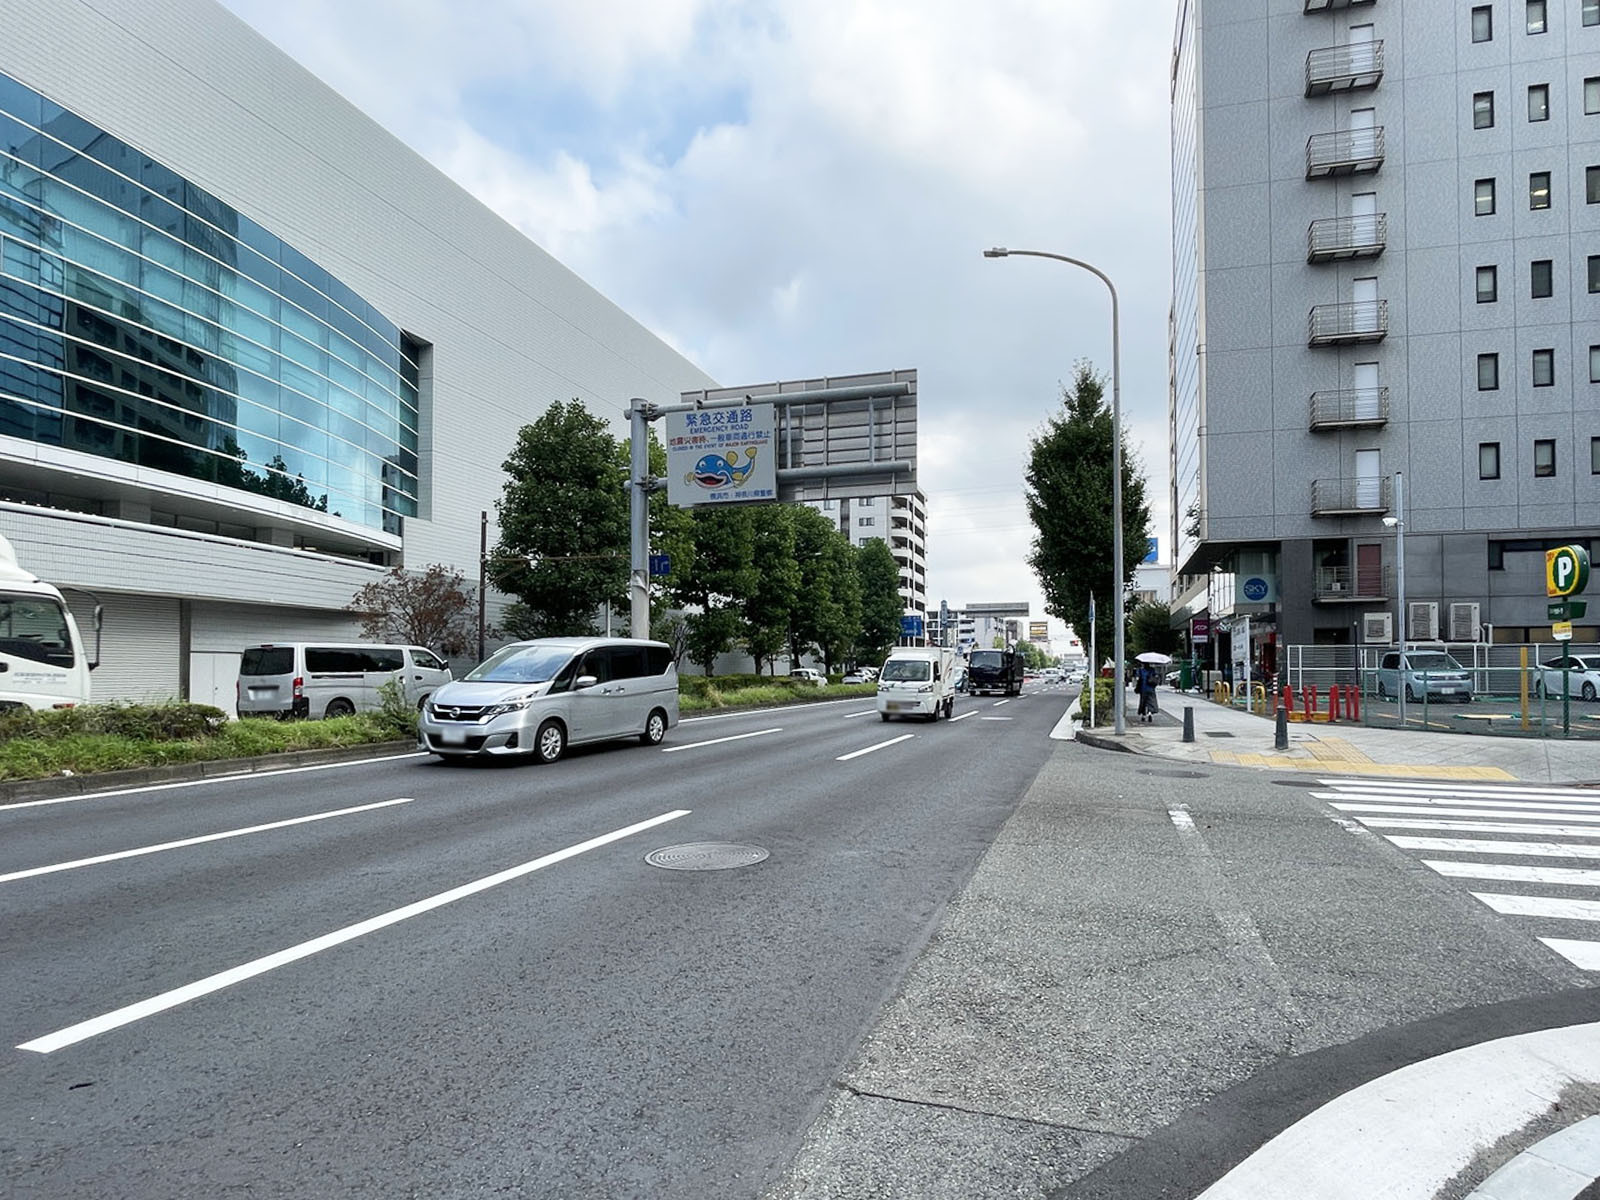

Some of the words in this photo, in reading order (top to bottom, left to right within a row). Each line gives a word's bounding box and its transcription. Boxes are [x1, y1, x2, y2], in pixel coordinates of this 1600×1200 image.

[685, 408, 753, 427] 緊急交通路
[690, 426, 728, 434] EMERGENCY
[1558, 556, 1573, 588] P
